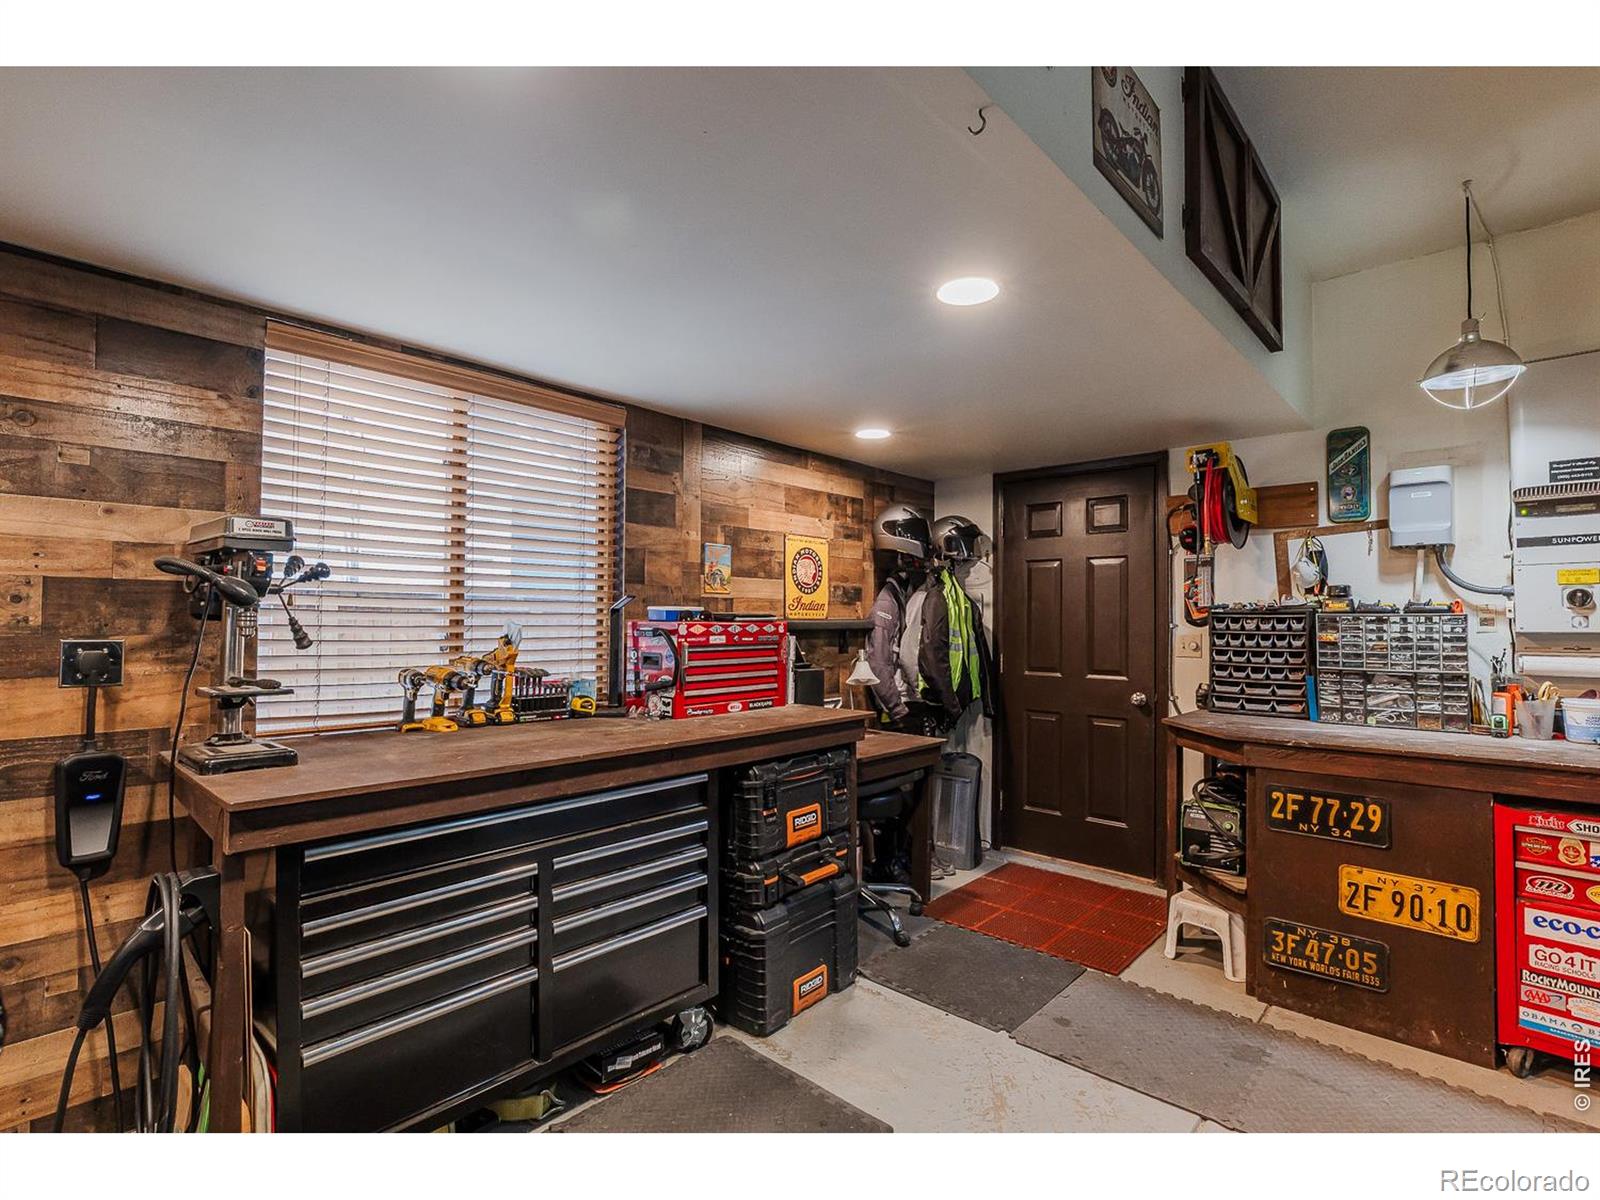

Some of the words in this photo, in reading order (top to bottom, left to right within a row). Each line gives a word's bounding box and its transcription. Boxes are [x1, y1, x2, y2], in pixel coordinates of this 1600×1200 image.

[788, 595, 825, 611] Indian
[1271, 791, 1304, 821] 2F
[794, 812, 817, 827] RIDGID
[1299, 823, 1320, 833] NY
[1330, 827, 1352, 838] 34
[1377, 876, 1399, 887] NY
[1413, 883, 1438, 894] 37
[1346, 881, 1382, 911] 2F
[1271, 930, 1300, 955] 3F
[1329, 935, 1351, 947] 38
[1271, 952, 1287, 964] NEW
[1289, 956, 1308, 969] YORK
[1342, 969, 1360, 983] FAIR
[1534, 949, 1562, 965] GO
[1564, 956, 1577, 969] 4
[1580, 959, 1597, 973] IT
[1534, 960, 1560, 972] RACING
[1562, 966, 1597, 980] SCHOOLS
[800, 975, 824, 994] RIDGID
[1524, 989, 1551, 1004] AAA
[1521, 1010, 1567, 1028] OBAMA
